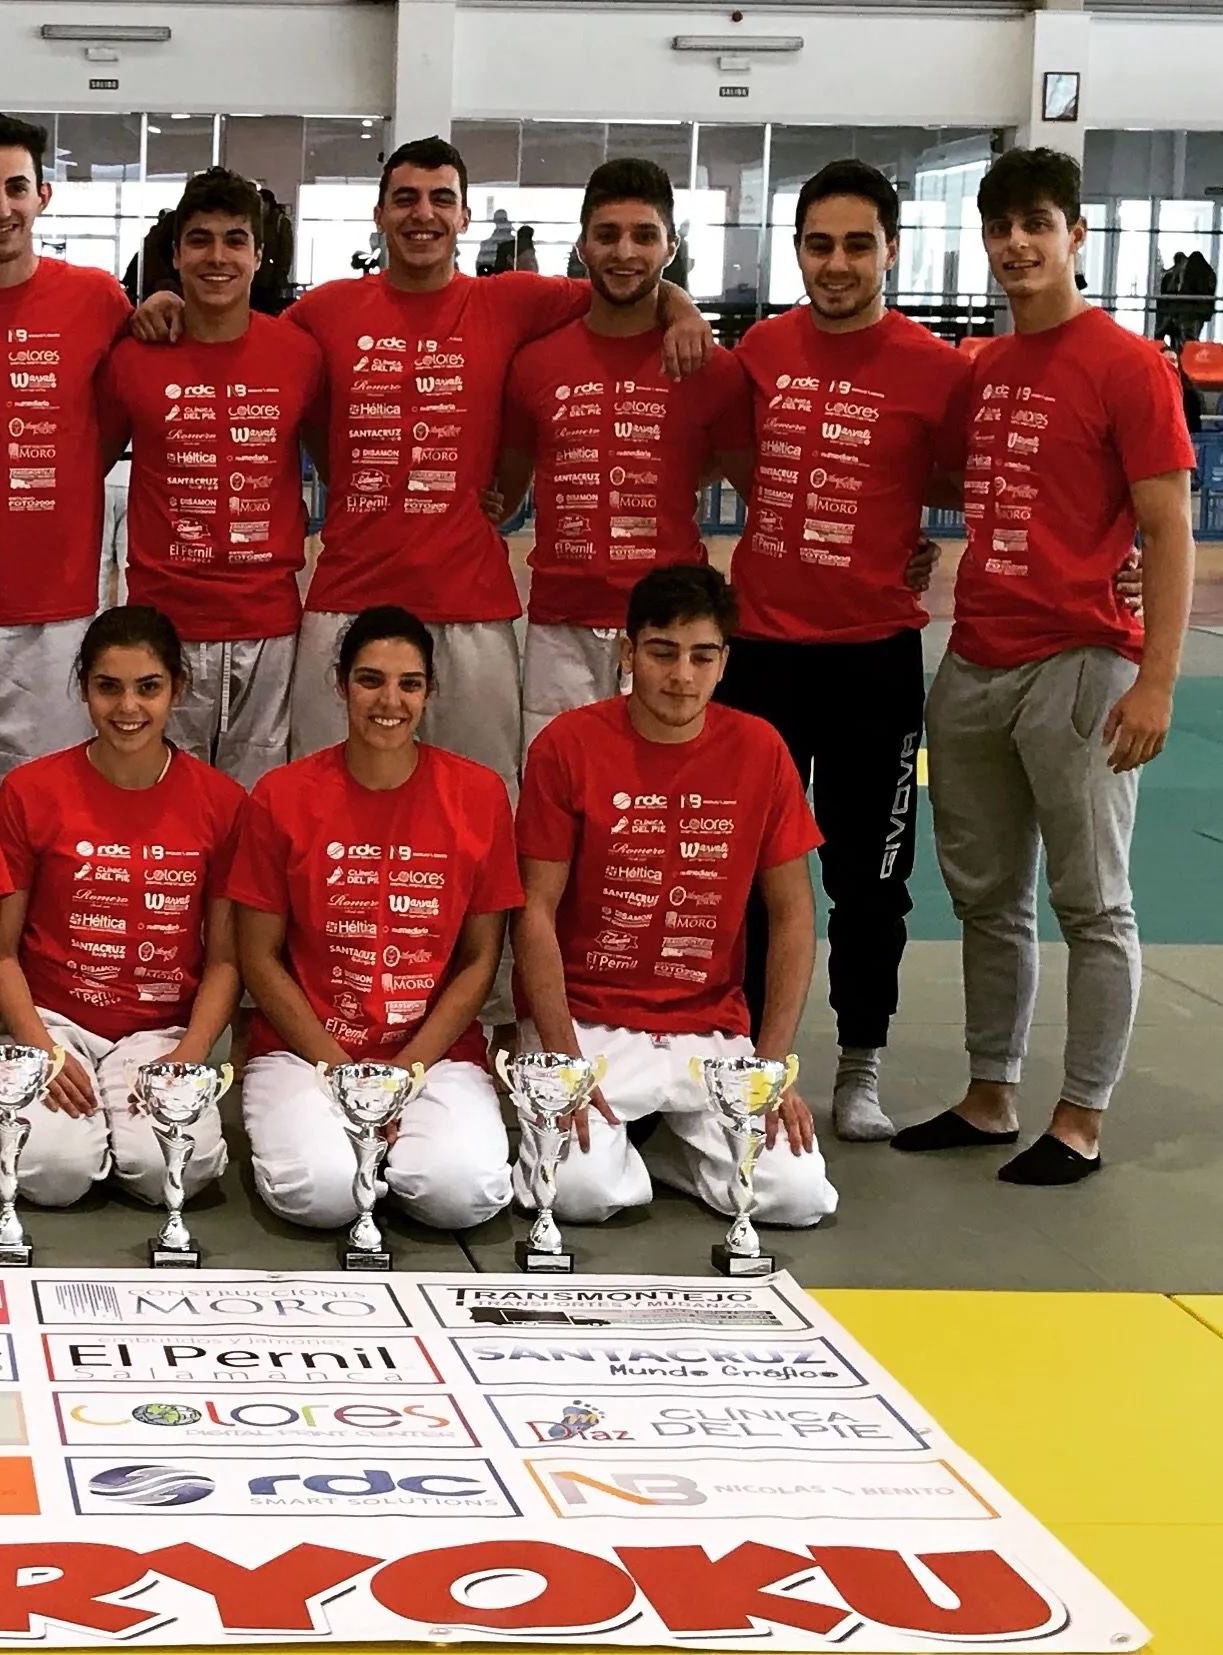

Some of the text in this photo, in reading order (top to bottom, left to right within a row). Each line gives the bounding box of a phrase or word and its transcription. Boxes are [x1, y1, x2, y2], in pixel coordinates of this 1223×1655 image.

[376, 338, 406, 350] rdc
[574, 382, 604, 393] rdc
[791, 376, 819, 388] rdc
[185, 385, 216, 396] rdc
[360, 404, 401, 416] Héltica
[177, 452, 216, 464] Héltica
[635, 795, 667, 806] rdc
[98, 844, 130, 856] rdc
[349, 845, 381, 857] rdc
[619, 867, 663, 881] Héltica
[83, 914, 126, 929] Héltica
[393, 977, 435, 990] MORO
[127, 1288, 367, 1298] CONSTRUCCIONES
[447, 1288, 753, 1306] TRANSMONTEJO
[136, 1296, 376, 1317] MORO
[477, 1300, 627, 1309] TRANSPORTES
[645, 1301, 759, 1309] MUDANZAS
[69, 1344, 398, 1369] El Pernil
[473, 1344, 829, 1364] SANTACRUZ
[659, 1407, 860, 1423] CLÍNICA
[651, 1422, 894, 1440] DEL PIE
[248, 1469, 487, 1497] rdc
[714, 1485, 955, 1496] NICOLAS BENITO
[250, 1497, 499, 1507] SMART SOLUTIONS
